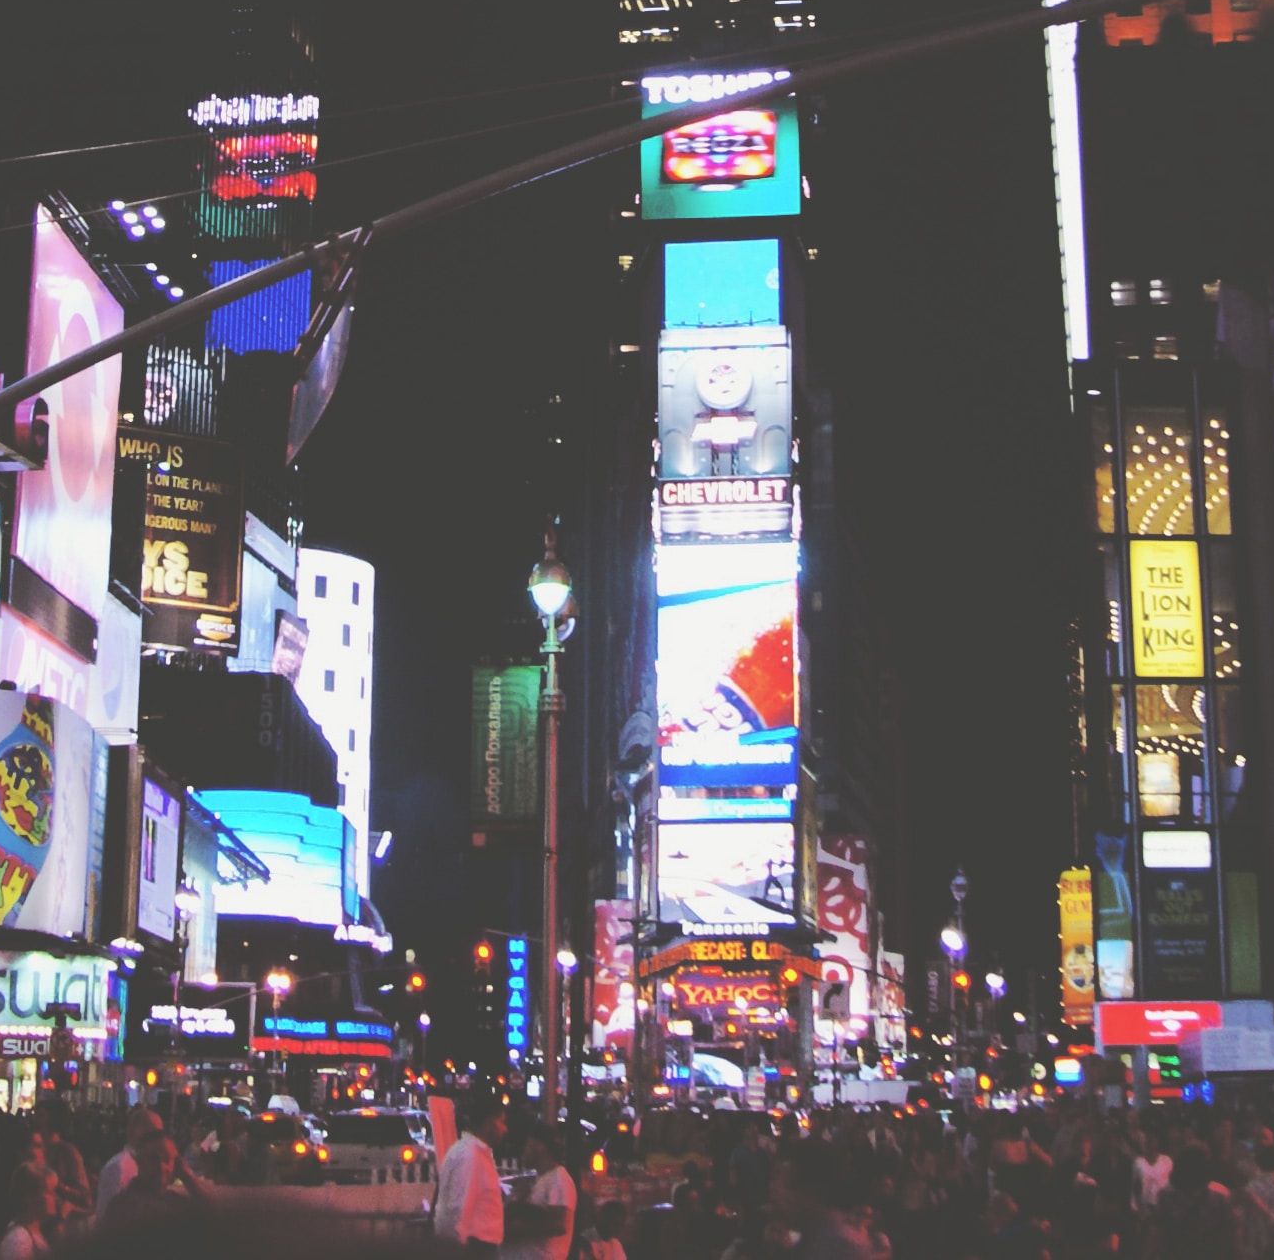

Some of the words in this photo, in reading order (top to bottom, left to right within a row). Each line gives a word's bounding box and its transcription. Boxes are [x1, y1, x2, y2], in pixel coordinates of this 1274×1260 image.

[168, 445, 183, 468] IS
[155, 473, 170, 487] ON
[172, 475, 190, 490] THE
[662, 479, 787, 505] CHEVROLET
[153, 494, 171, 509] THE
[174, 496, 203, 513] YEAR?
[190, 518, 217, 535] MAN?
[1146, 567, 1183, 584] THE
[1140, 590, 1192, 621] LION
[1141, 626, 1195, 658] KING
[681, 920, 770, 936] Panasonic
[2, 1038, 51, 1055] swa
